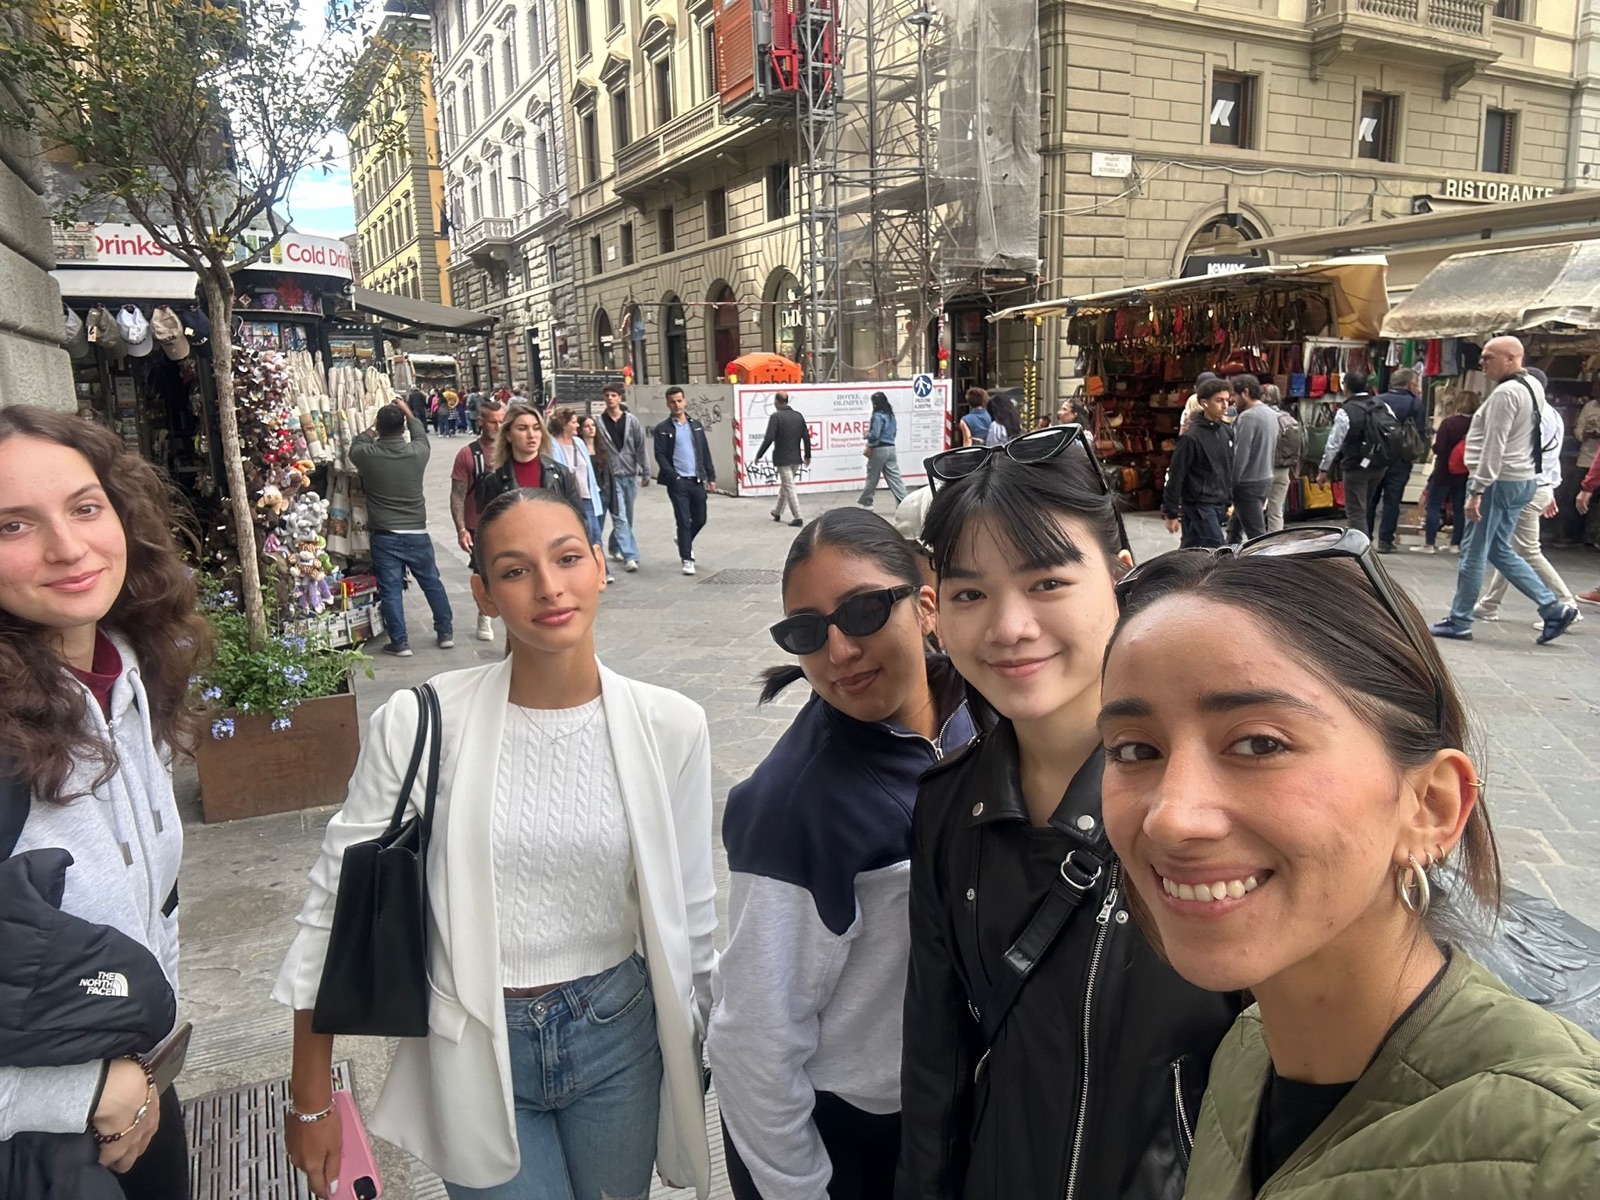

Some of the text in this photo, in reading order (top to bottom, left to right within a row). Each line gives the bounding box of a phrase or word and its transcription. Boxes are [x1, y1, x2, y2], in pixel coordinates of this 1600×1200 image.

[1446, 179, 1554, 202] RISTORANTE
[286, 243, 349, 268] Cold Drin
[98, 971, 116, 981] THE
[79, 978, 113, 988] NORTH
[86, 987, 113, 997] FACE
